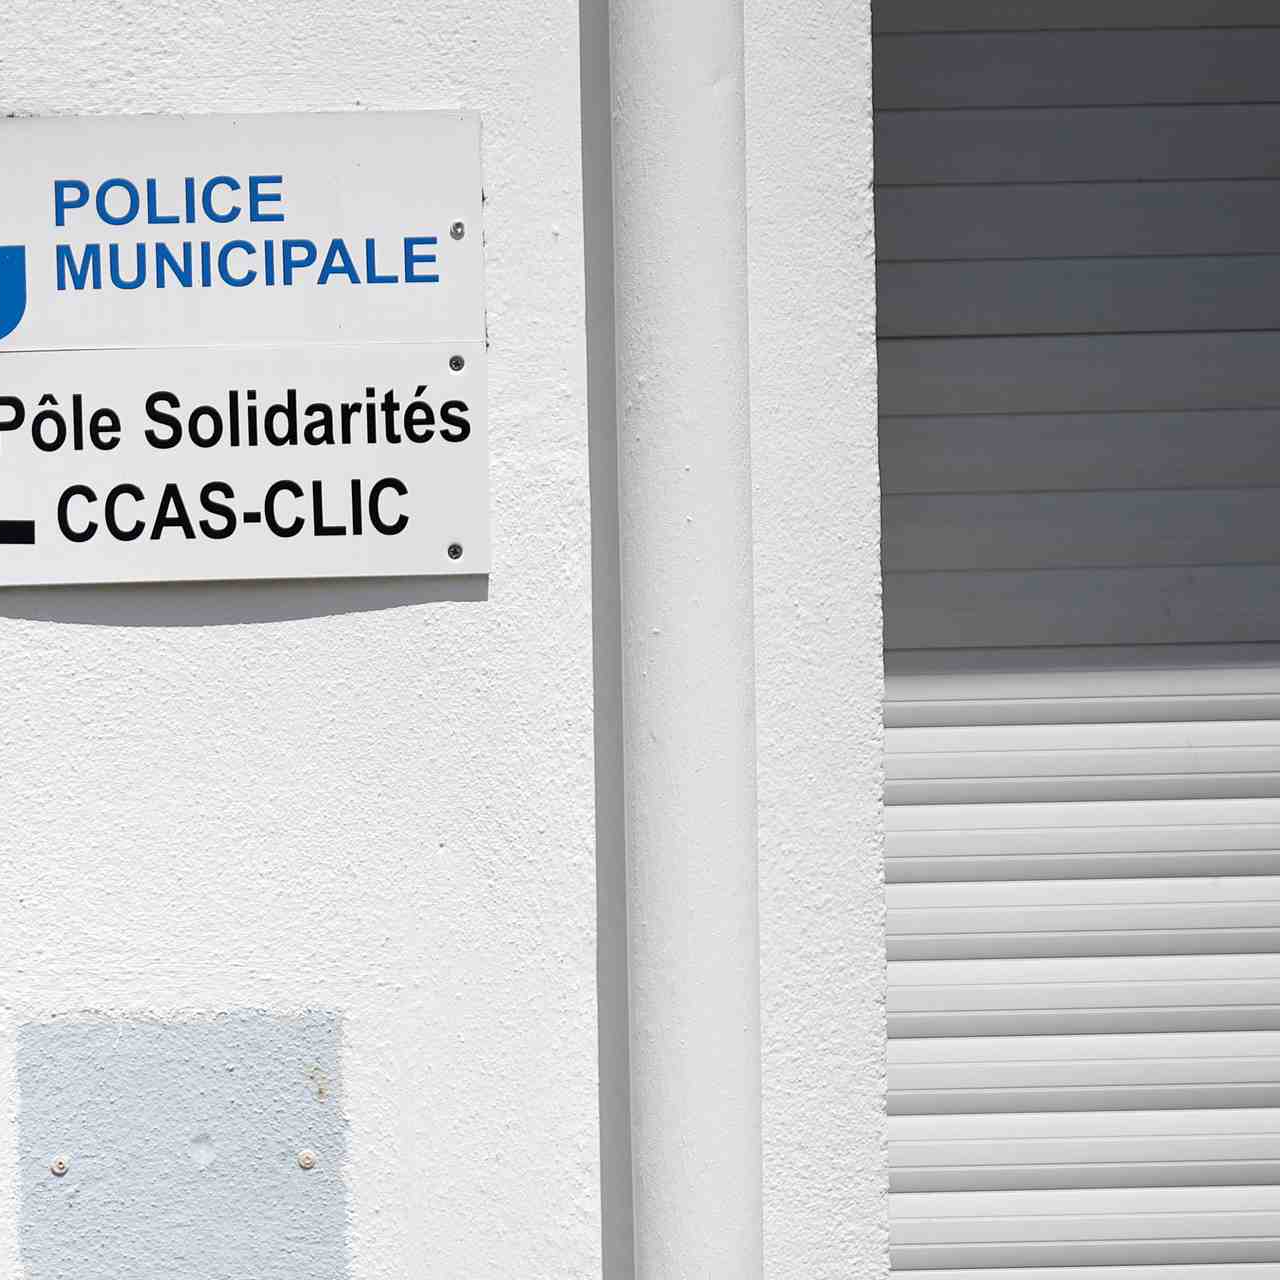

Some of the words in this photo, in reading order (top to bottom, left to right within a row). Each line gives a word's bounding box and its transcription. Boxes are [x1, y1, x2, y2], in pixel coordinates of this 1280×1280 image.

[54, 175, 285, 227] POLICE
[55, 236, 440, 291] MUNICIPALE
[144, 384, 471, 450] Solidarités
[57, 477, 410, 543] CCAS-CLIC
